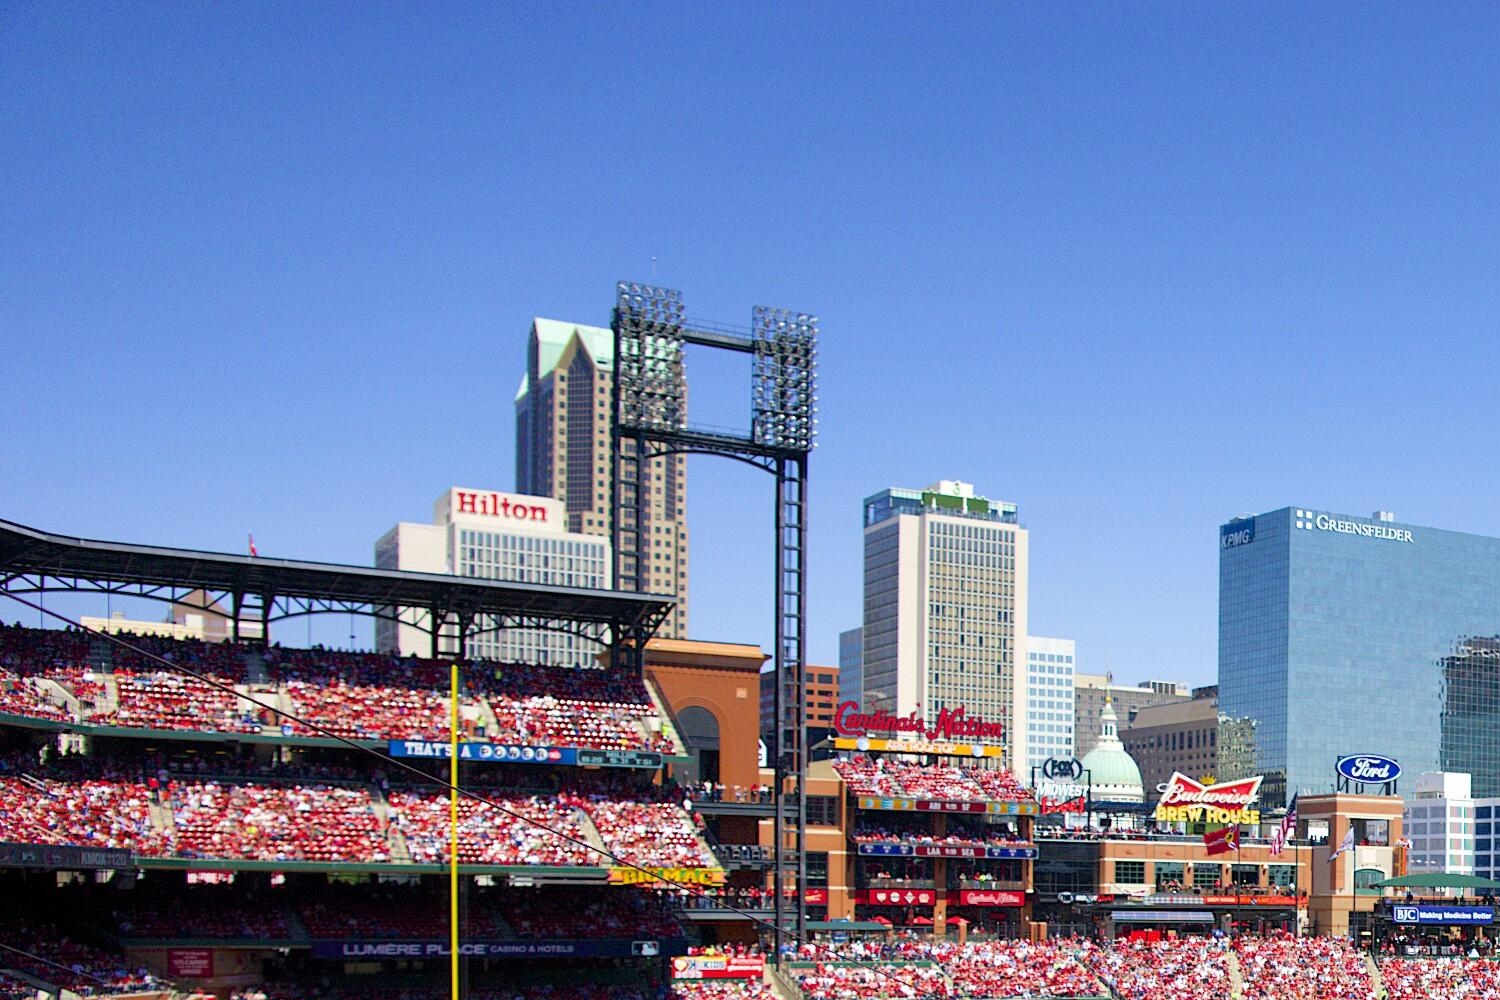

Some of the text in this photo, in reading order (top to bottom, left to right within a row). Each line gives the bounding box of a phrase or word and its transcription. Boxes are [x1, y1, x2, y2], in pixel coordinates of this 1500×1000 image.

[457, 492, 548, 521] Hilton
[1316, 514, 1414, 543] GREENSFELDER
[1221, 527, 1251, 549] KPMG
[834, 700, 1003, 740] Cardinals Nation
[461, 744, 471, 757] A
[1050, 759, 1074, 771] FOX
[1351, 757, 1391, 779] Ford
[1036, 782, 1089, 798] MIDWEST
[1156, 779, 1259, 805] Budweiser
[1156, 807, 1261, 825] BREW HOUSE
[81, 852, 127, 866] KMOX 1120
[622, 868, 713, 885] BIG MAC
[1396, 909, 1493, 921] BJC Making Medicine Better
[490, 945, 526, 954] CASINO
[537, 945, 574, 954] HOTELS
